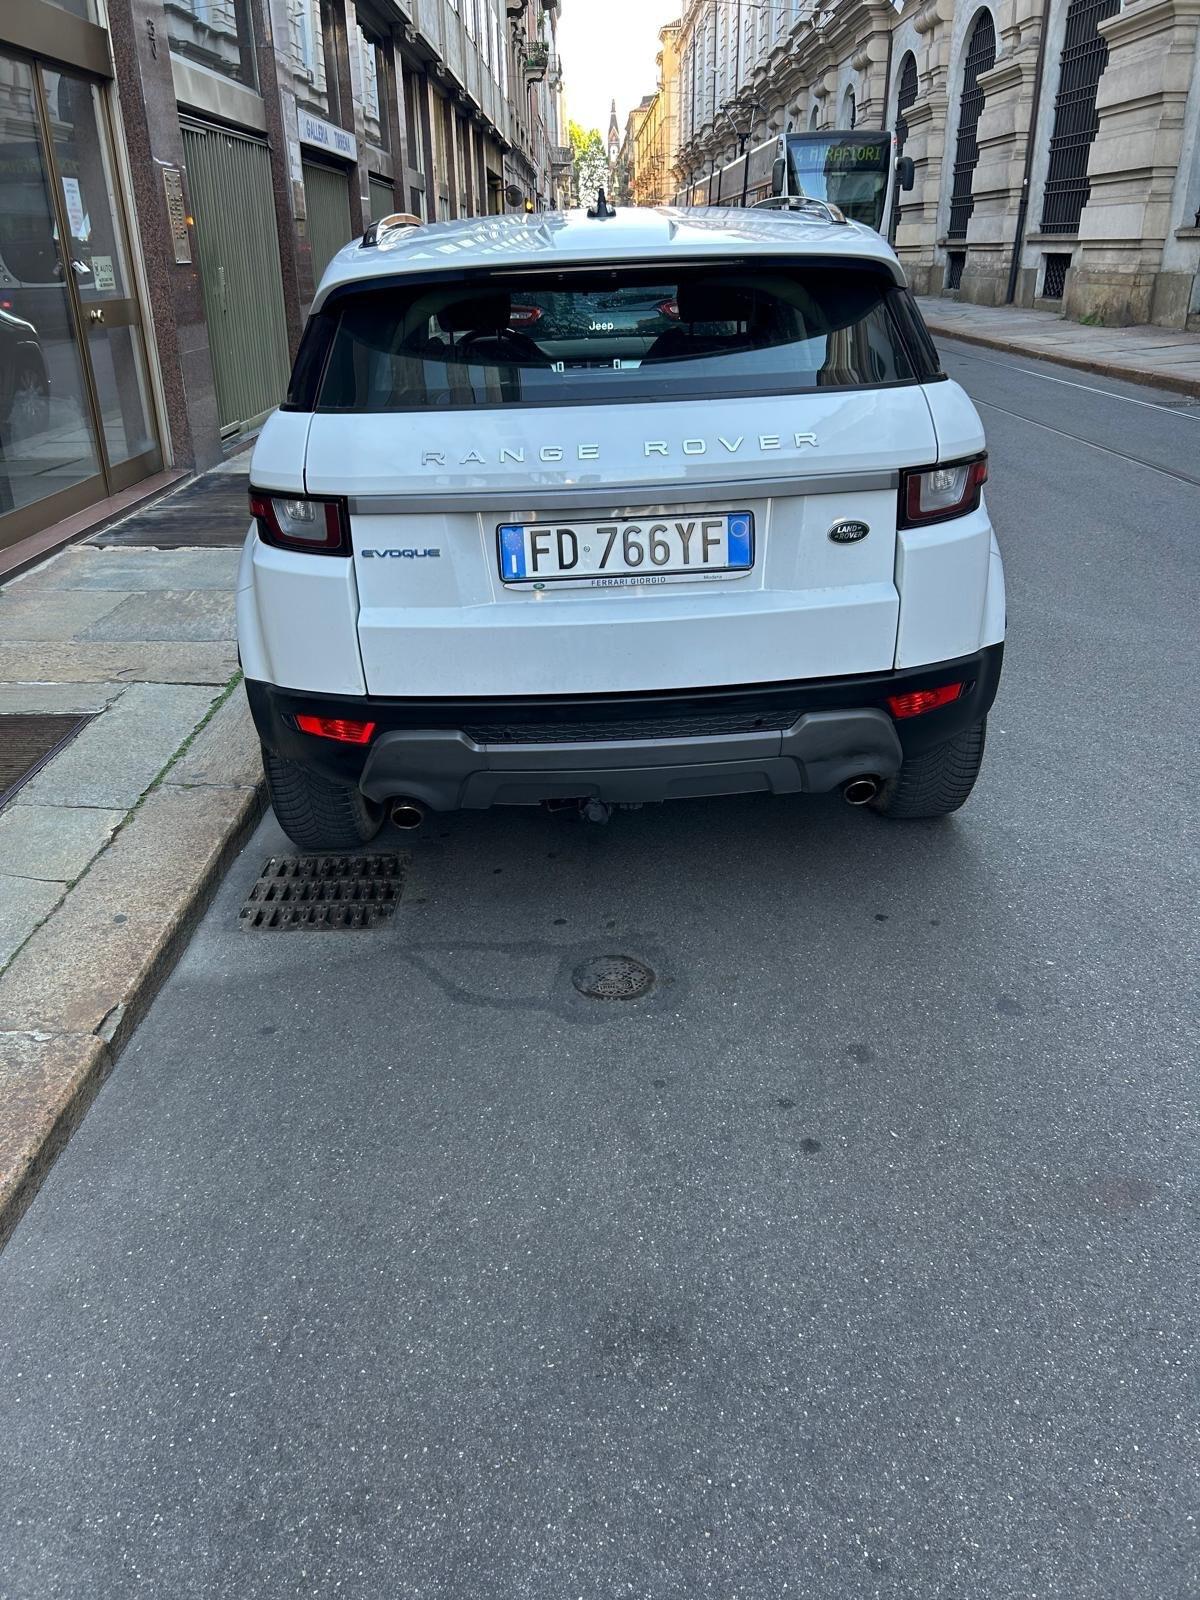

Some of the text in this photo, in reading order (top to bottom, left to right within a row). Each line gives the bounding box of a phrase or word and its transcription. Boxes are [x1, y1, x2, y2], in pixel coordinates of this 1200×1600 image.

[306, 119, 329, 145] GALLERIA
[809, 145, 881, 162] MIRAFIORI
[589, 321, 614, 333] Jeep
[421, 431, 820, 466] RANGE ROVER
[361, 548, 441, 559] EVOQUE
[530, 528, 579, 572] FD
[596, 520, 723, 569] 766YF
[591, 577, 628, 587] FERRARI
[630, 576, 667, 585] GIORGIO
